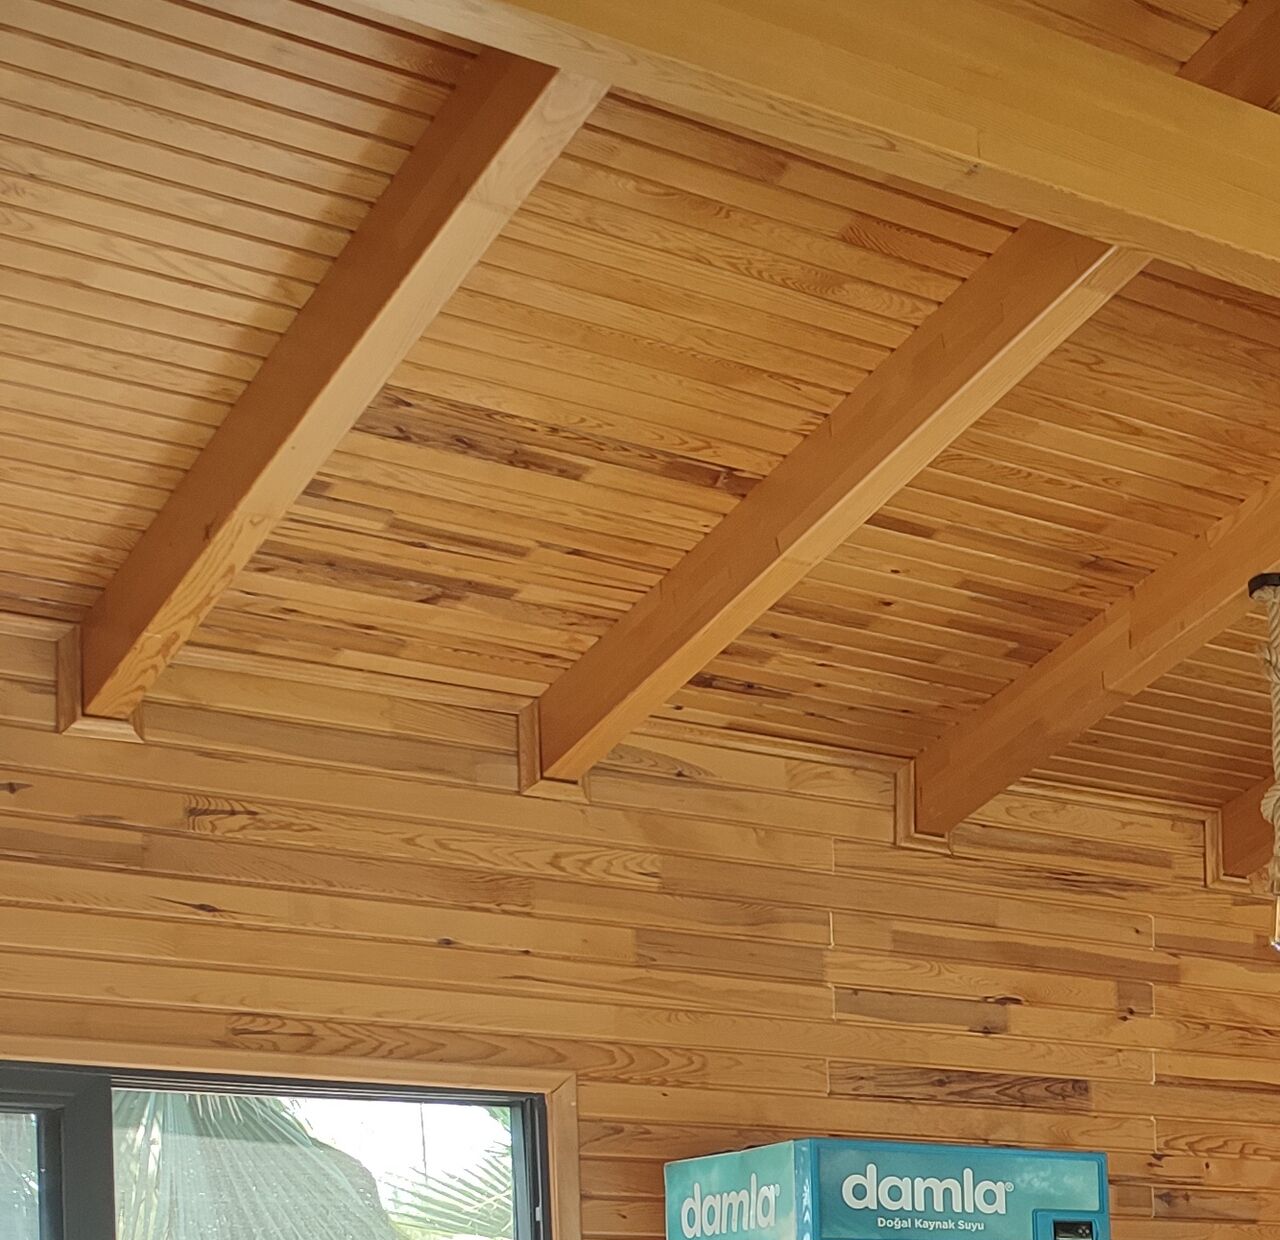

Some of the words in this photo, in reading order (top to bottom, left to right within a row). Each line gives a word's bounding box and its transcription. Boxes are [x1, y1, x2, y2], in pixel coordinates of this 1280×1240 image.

[681, 1172, 775, 1239] damla
[842, 1163, 1006, 1214] damla
[877, 1217, 911, 1229] Doğal
[914, 1219, 955, 1231] Kaynak
[958, 1220, 984, 1232] Suyu
